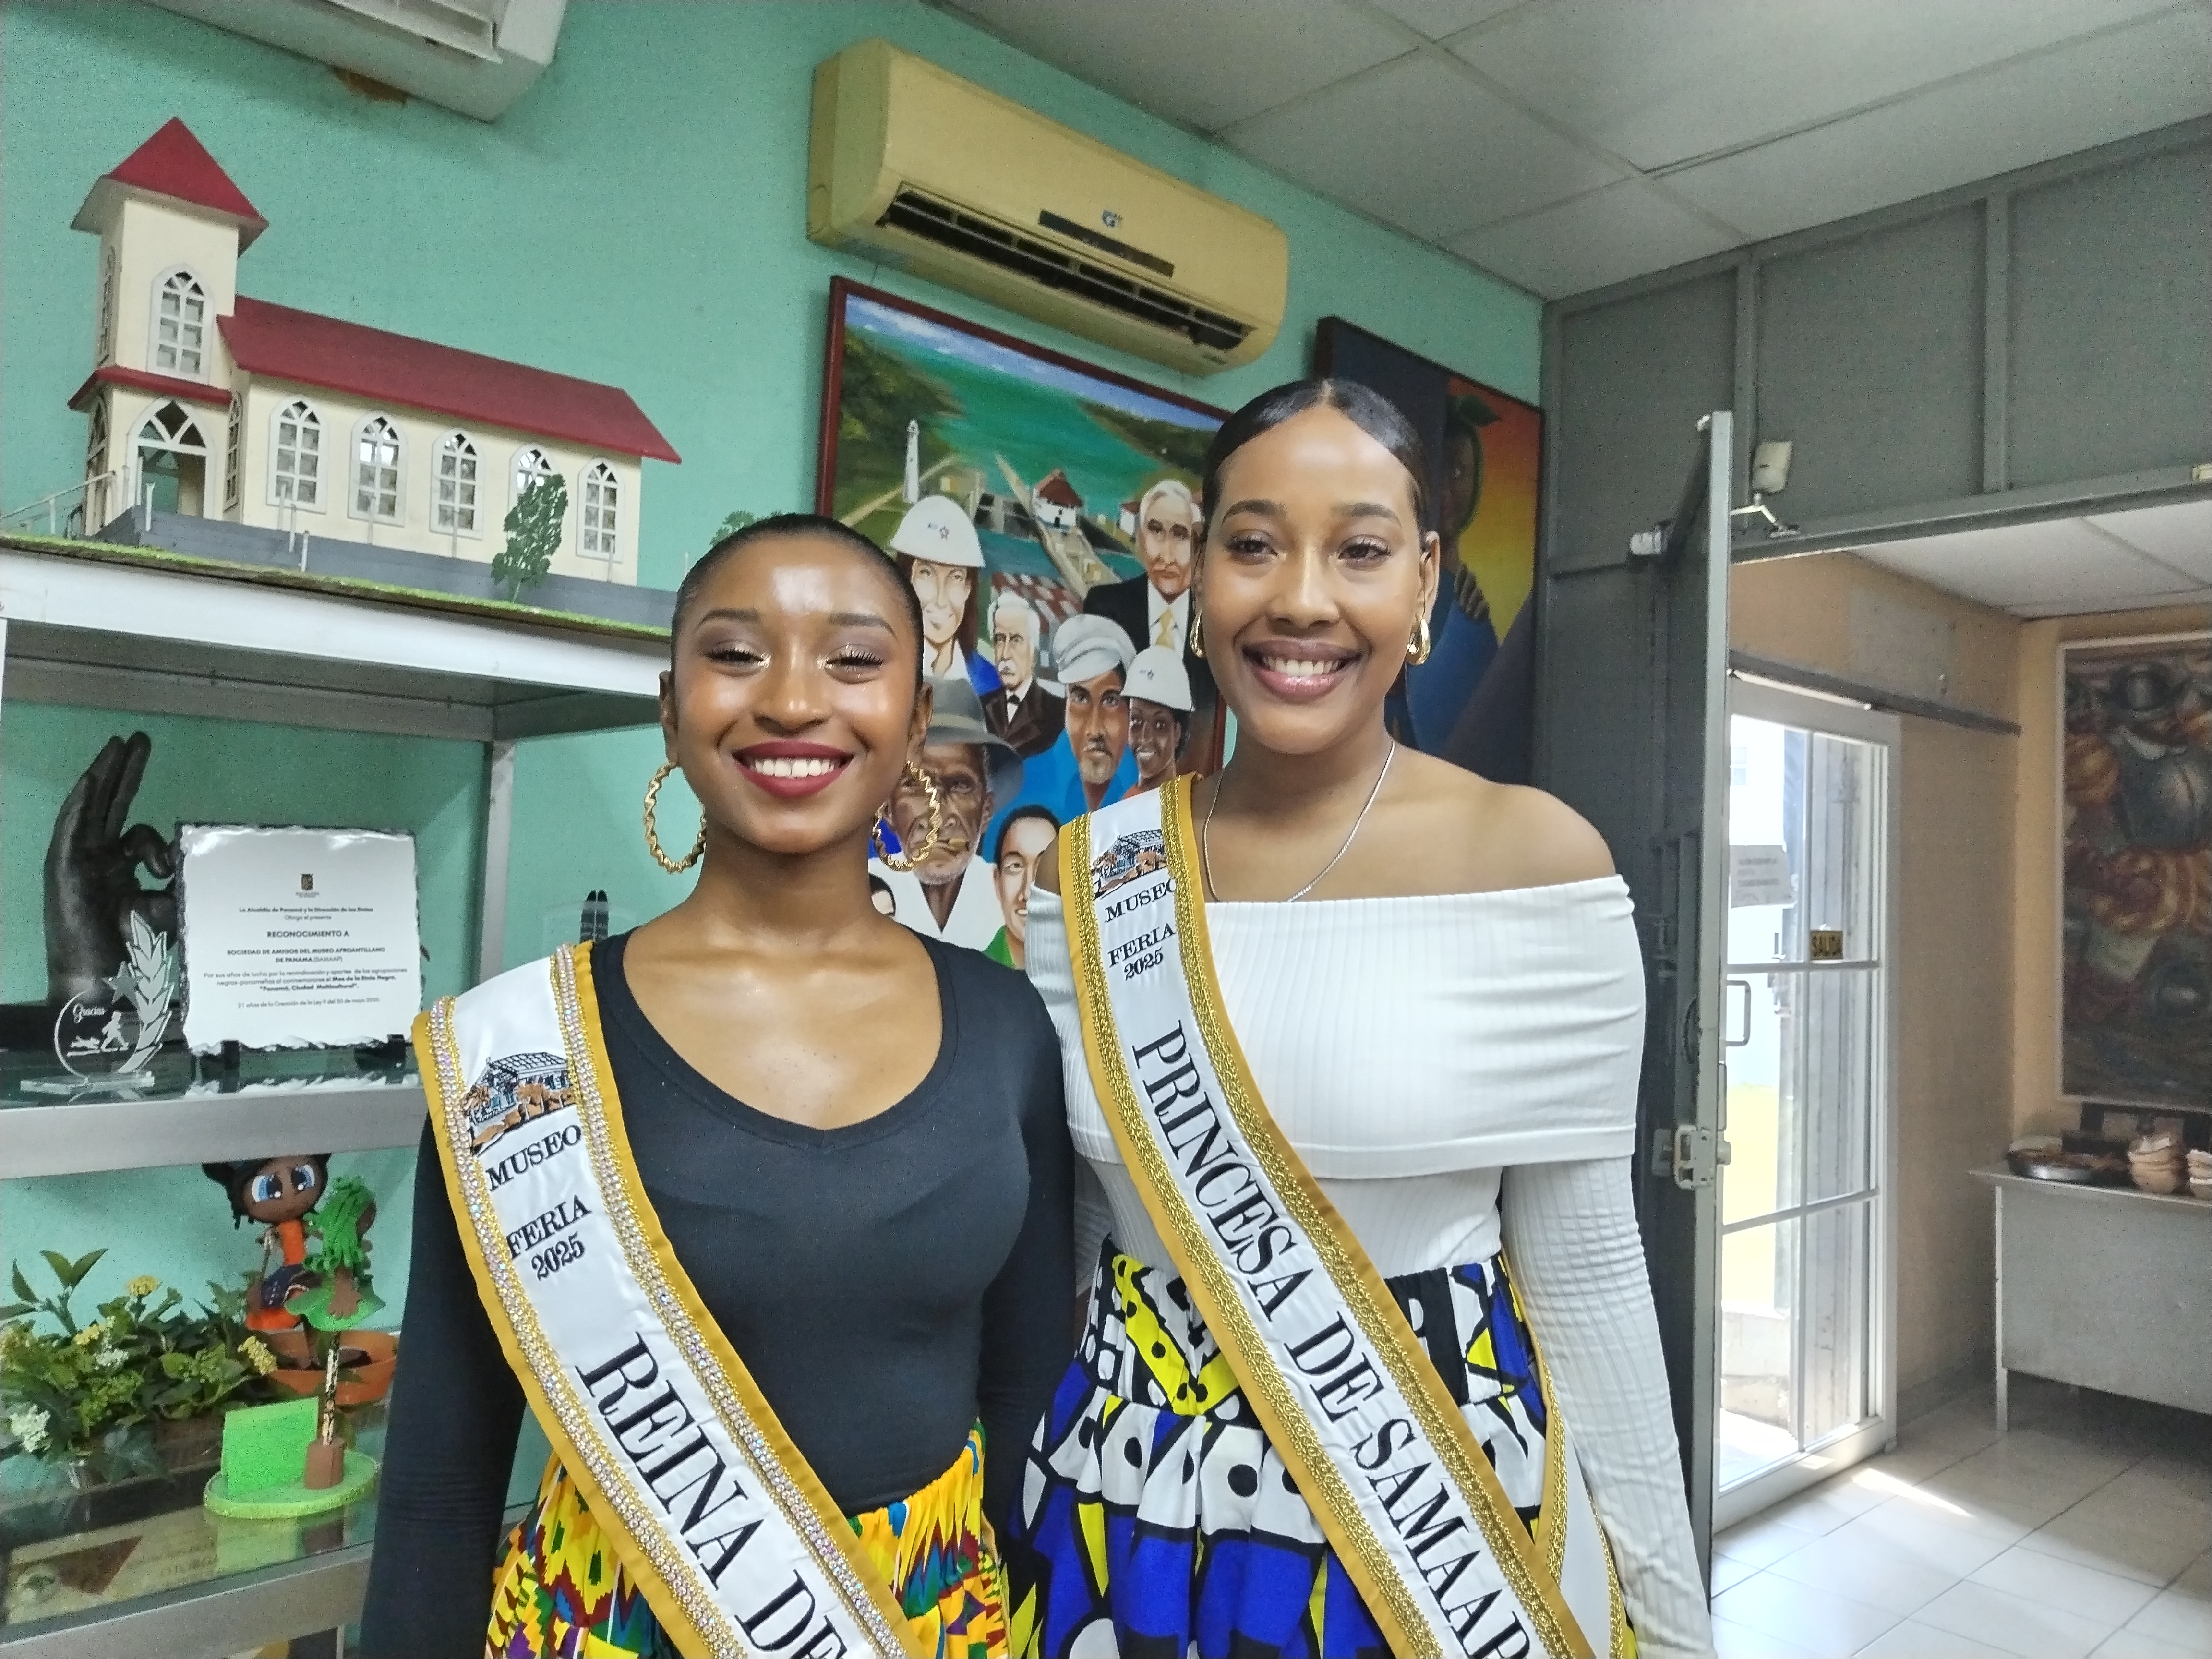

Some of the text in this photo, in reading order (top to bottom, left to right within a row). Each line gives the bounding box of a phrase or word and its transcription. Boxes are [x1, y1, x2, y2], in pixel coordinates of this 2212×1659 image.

[1107, 923, 1176, 968] FERIA
[1124, 947, 1164, 981] 2025
[485, 1124, 583, 1191] MUSEO
[506, 1194, 592, 1260] FERIA
[531, 1232, 586, 1281] 2025
[1131, 1019, 1530, 1659] PRINCESA DE SAMAAP
[575, 1331, 764, 1590] REINA
